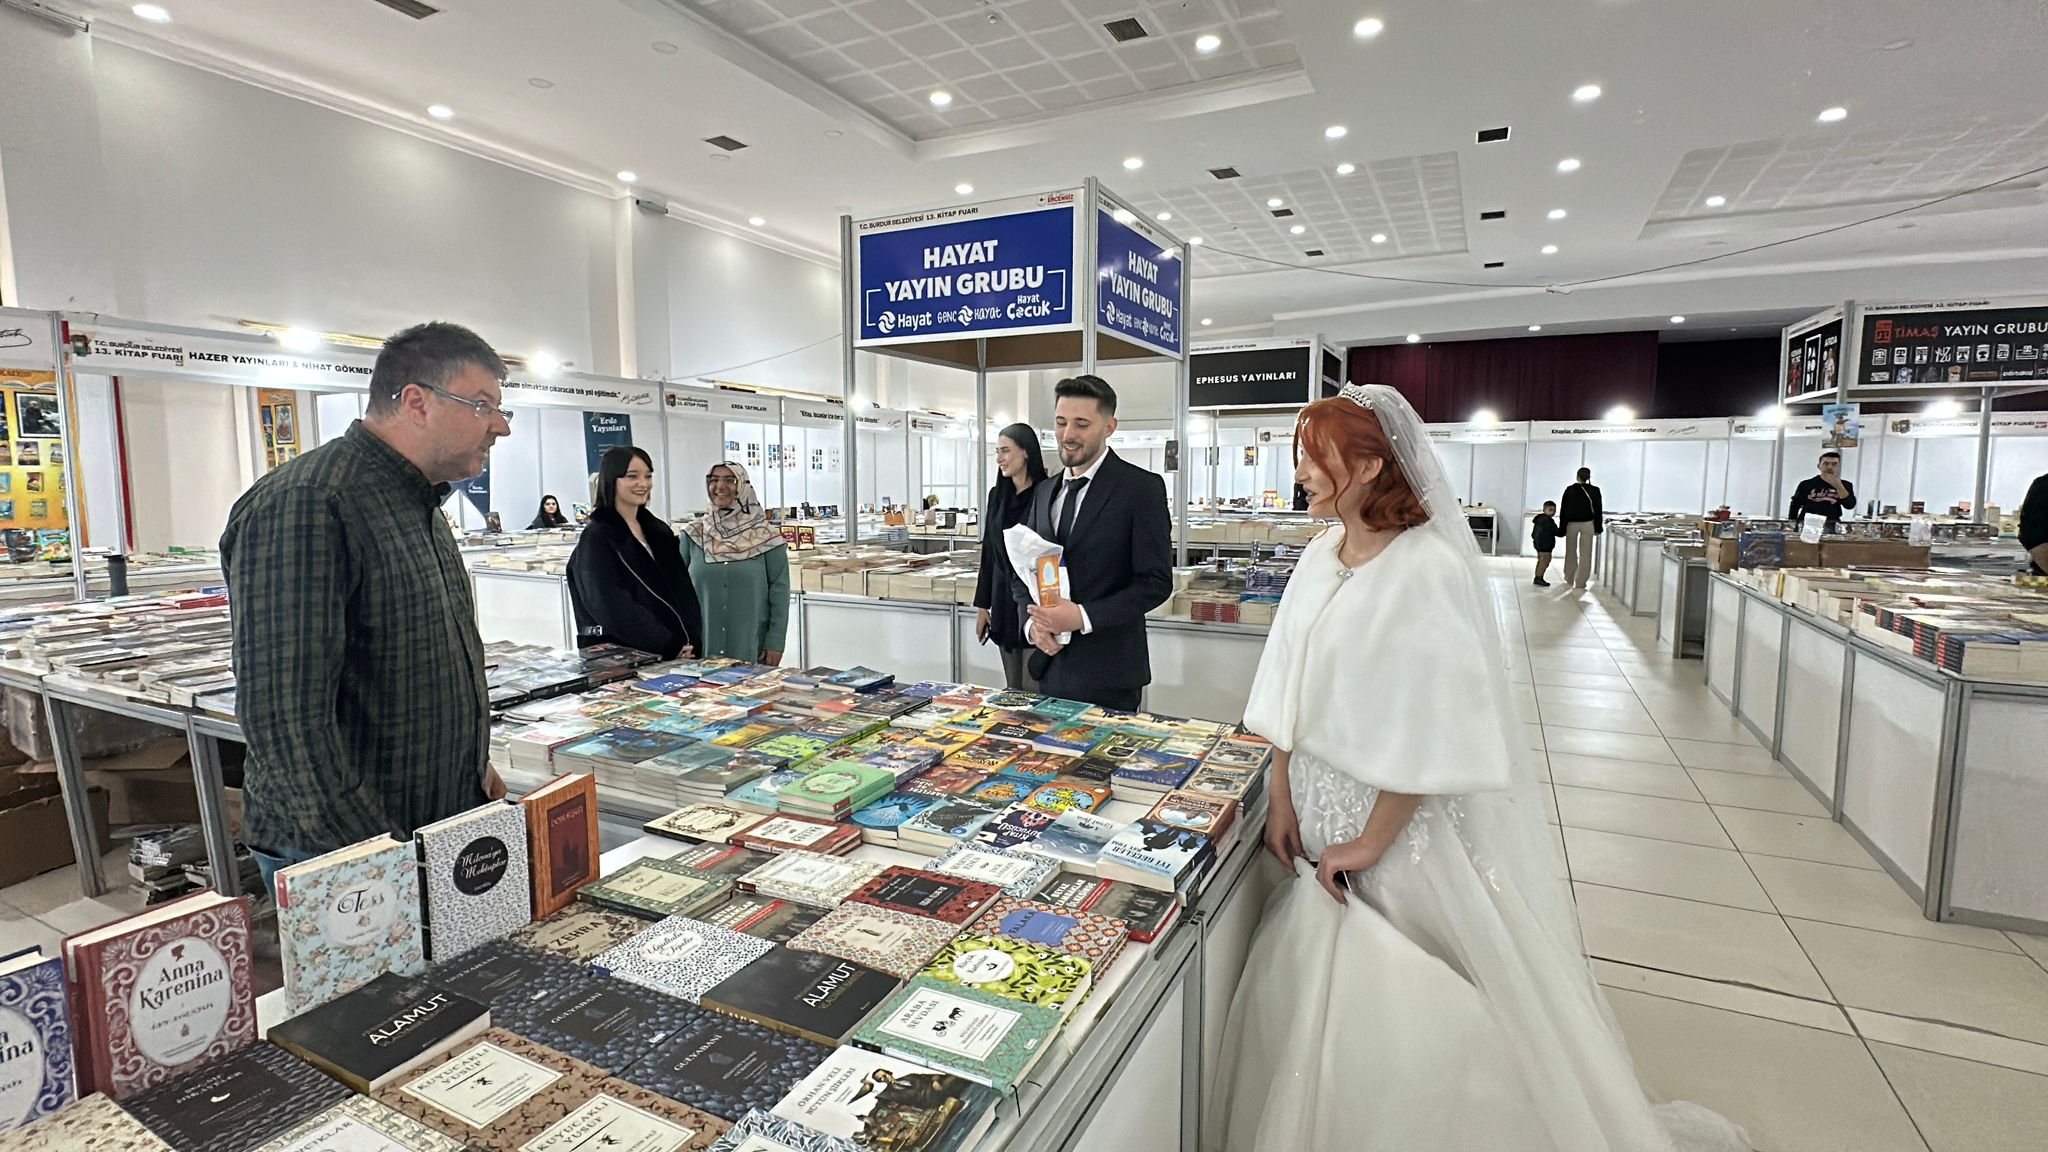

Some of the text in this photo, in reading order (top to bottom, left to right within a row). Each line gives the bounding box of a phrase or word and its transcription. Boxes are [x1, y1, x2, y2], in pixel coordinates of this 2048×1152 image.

[869, 220, 891, 229] BURDUR
[937, 210, 957, 219] KİTAP
[958, 207, 979, 216] FUARI
[923, 239, 998, 270] HAYAT
[1128, 250, 1158, 285] HAYAT
[885, 265, 1044, 302] YAYIN GRUBU
[1110, 267, 1173, 319] YAYIN GRUBU
[1017, 293, 1040, 305] Hayat
[897, 311, 932, 331] Hayat
[1115, 307, 1133, 330] Hayat
[1943, 324, 1989, 337] YAYIN
[1993, 321, 2048, 335] GRUBU
[94, 347, 184, 361] 13. KİTAP FUARI
[188, 351, 229, 362] HAZER
[232, 355, 289, 367] YAYINLARI
[302, 362, 332, 371] NİHAT
[521, 382, 548, 392] olmaktan
[549, 385, 575, 395] çıkaracak
[575, 387, 585, 395] tek
[1196, 371, 1297, 385] EPHESUS YAYINLARI
[591, 425, 627, 433] Yayınları
[600, 417, 618, 425] Erda
[1112, 846, 1155, 863] GECELER
[337, 886, 385, 914] Tess
[550, 921, 604, 947] ZEHRA
[1009, 911, 1037, 935] FALAKA
[159, 959, 205, 983] Anna
[140, 969, 223, 1010] Karenina
[802, 961, 857, 1008] ALAMUT
[369, 993, 448, 1045] ALAMUT
[900, 998, 927, 1024] ARABA
[907, 999, 940, 1029] SEVDASI
[416, 1047, 490, 1091] KUYUCAKLI
[441, 1059, 482, 1085] YUSUF
[797, 1084, 823, 1107] ORHAN
[805, 1090, 832, 1115] BÜTÜN
[536, 1101, 610, 1151] KUYUCAKLI
[562, 1115, 603, 1145] YUSUF
